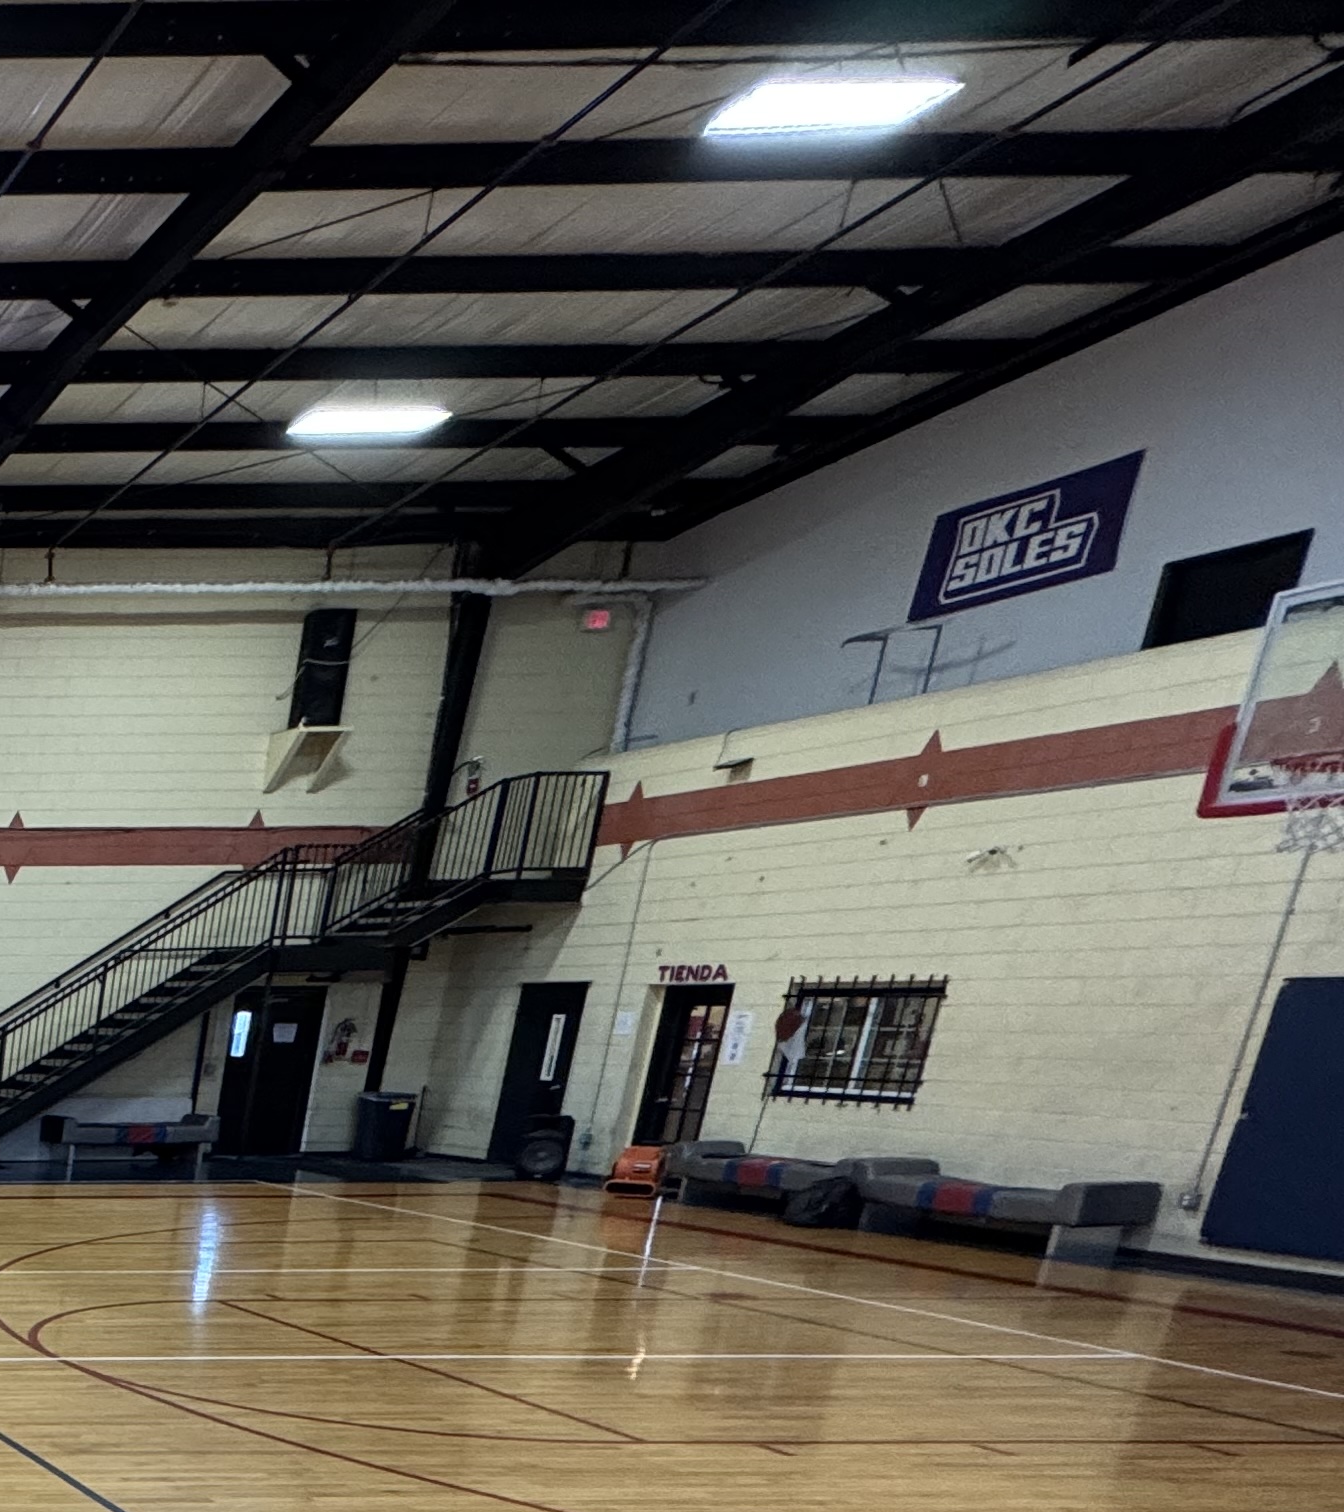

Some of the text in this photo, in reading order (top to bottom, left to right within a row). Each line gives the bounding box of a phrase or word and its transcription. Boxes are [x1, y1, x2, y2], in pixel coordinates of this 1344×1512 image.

[946, 521, 1088, 591] SOLES
[958, 497, 1050, 556] OKC
[658, 964, 728, 982] TIENDA
